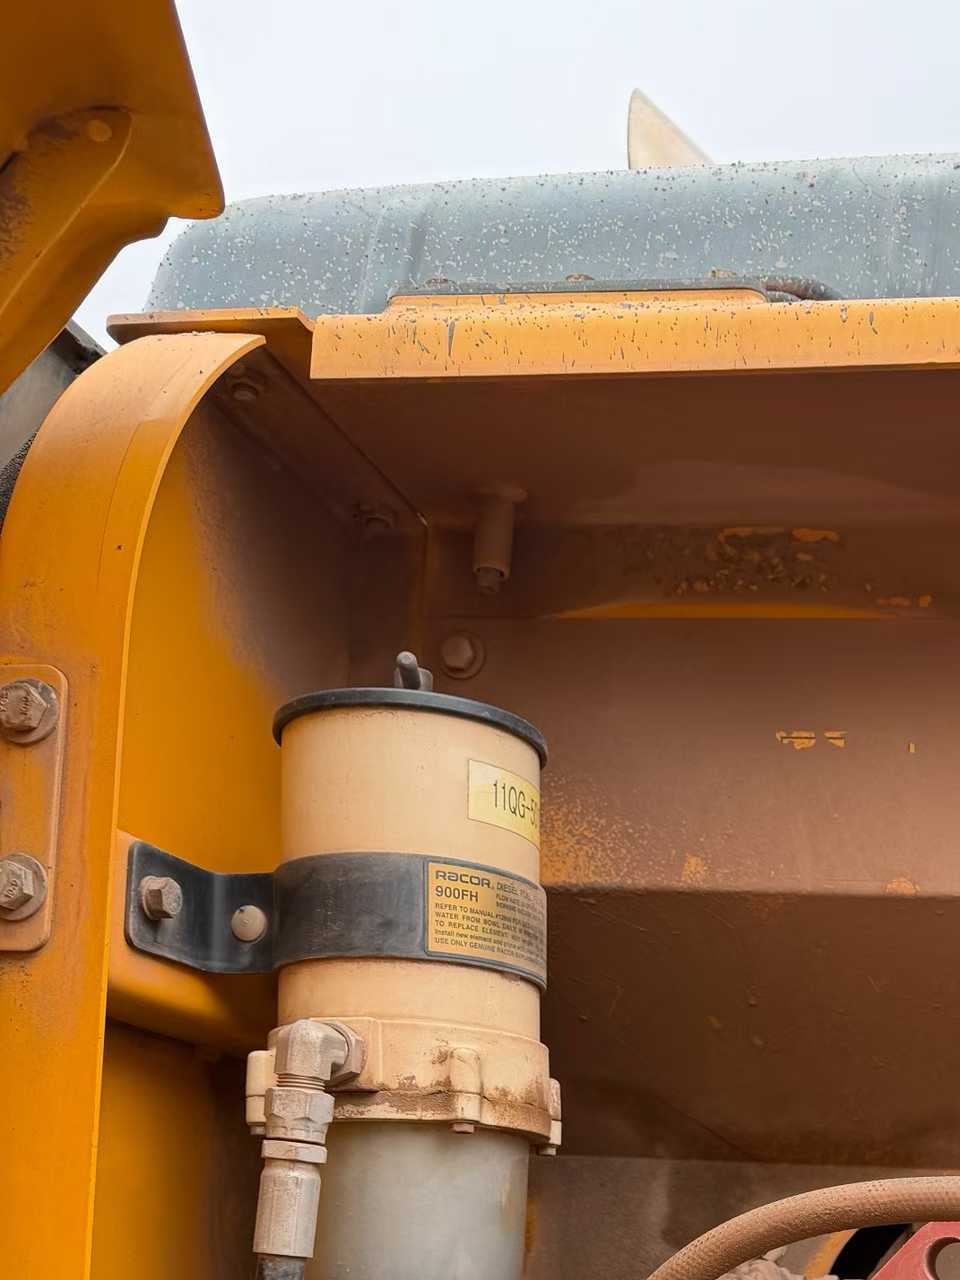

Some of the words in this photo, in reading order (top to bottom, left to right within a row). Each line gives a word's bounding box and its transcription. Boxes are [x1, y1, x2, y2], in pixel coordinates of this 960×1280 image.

[435, 885, 479, 903] 900FH
[435, 903, 457, 912] REFER
[470, 908, 494, 918] MANUAL
[435, 912, 458, 920] WATER
[463, 915, 481, 923] FROM
[449, 922, 478, 931] REPLACE
[435, 937, 449, 945] USE
[451, 939, 468, 947] ONLY
